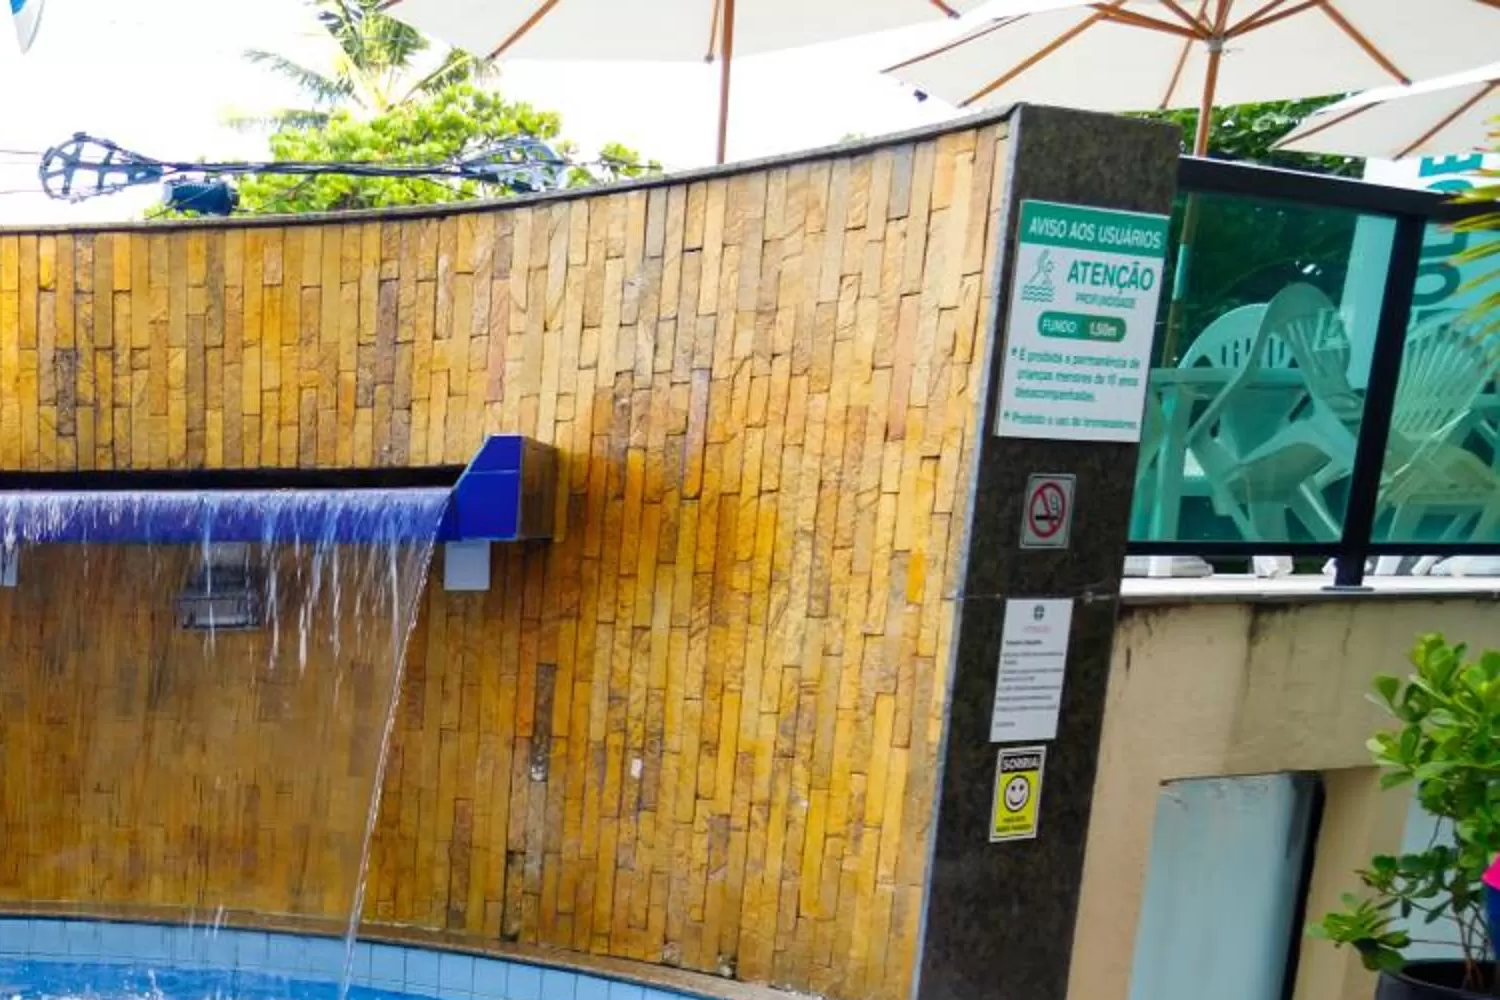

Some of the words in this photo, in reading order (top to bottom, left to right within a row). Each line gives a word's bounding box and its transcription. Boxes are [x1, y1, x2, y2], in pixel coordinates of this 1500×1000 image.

[1028, 216, 1067, 239] AVISO
[1068, 221, 1096, 242] AOS
[1098, 223, 1162, 250] USUÁRIOS
[1067, 259, 1155, 294] ATENÇÃO
[1042, 317, 1077, 333] FUNDO
